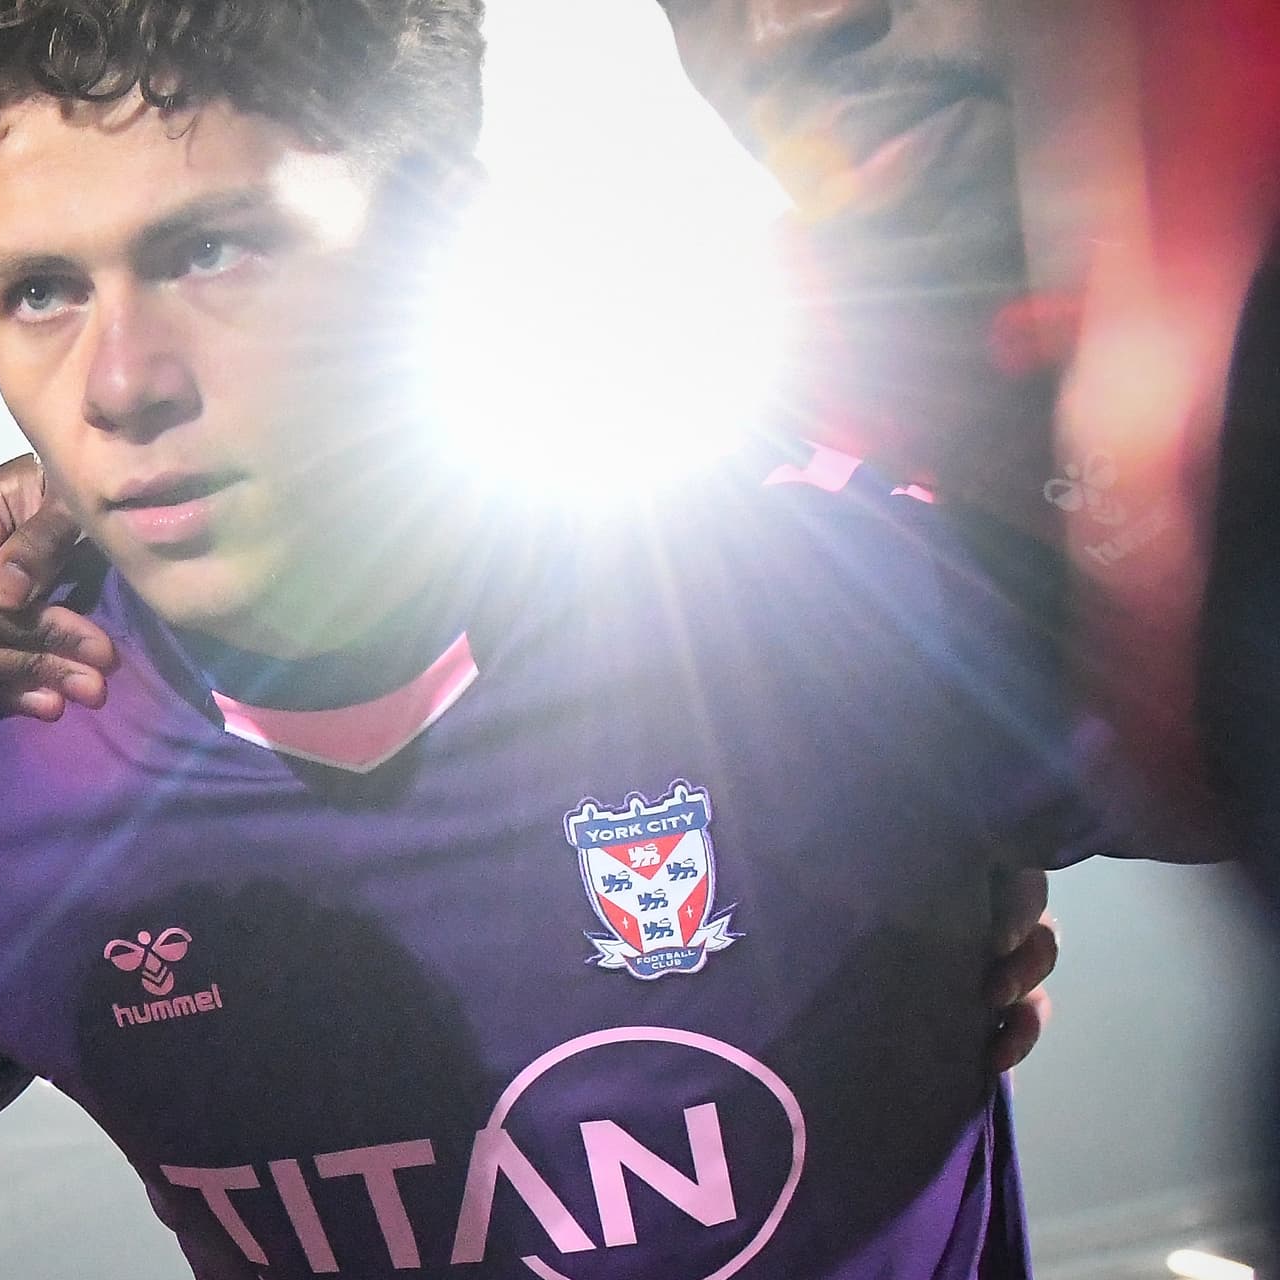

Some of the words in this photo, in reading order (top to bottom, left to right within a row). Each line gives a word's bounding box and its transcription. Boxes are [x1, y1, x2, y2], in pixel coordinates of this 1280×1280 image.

[585, 823, 643, 843] YORK
[646, 811, 696, 834] CITY
[636, 950, 697, 965] FOOTBALL
[650, 958, 683, 970] CLUB
[112, 983, 223, 1028] hummel
[160, 1101, 738, 1274] TITAN
